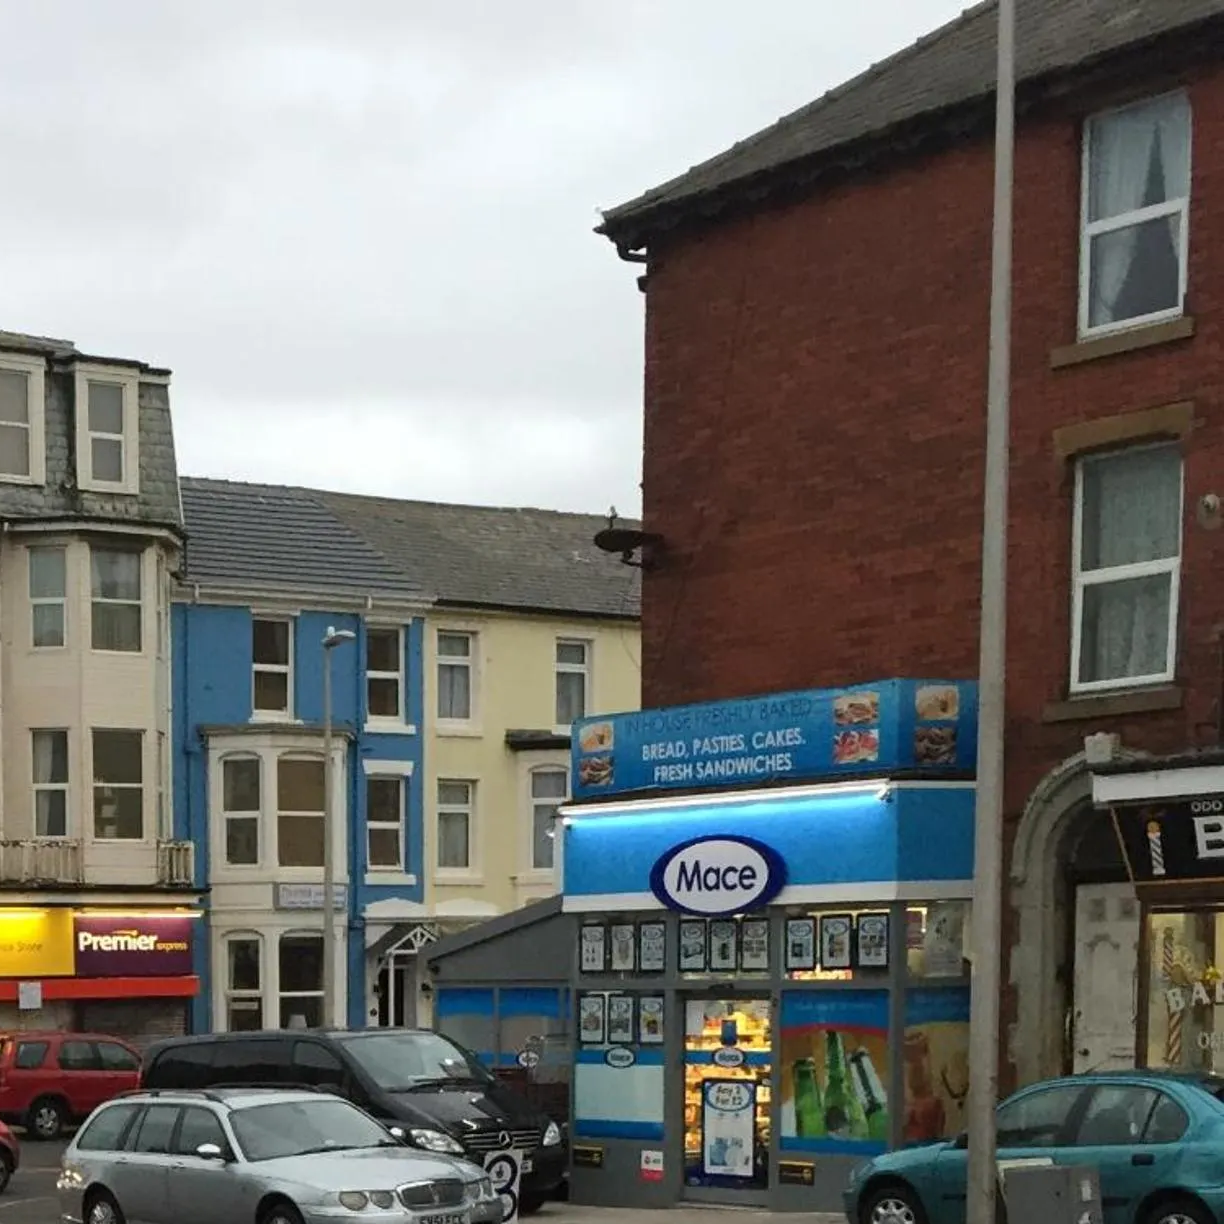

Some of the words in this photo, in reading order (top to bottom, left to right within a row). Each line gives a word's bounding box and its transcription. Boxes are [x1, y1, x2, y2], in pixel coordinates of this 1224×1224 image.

[695, 704, 753, 727] FRESHLY
[759, 698, 812, 721] BAKED
[654, 763, 693, 783] FRESH
[696, 754, 792, 780] SANDWICHES
[677, 859, 756, 893] Mace
[78, 931, 158, 952] Premier
[157, 942, 188, 953] express
[1167, 981, 1224, 1013] BA
